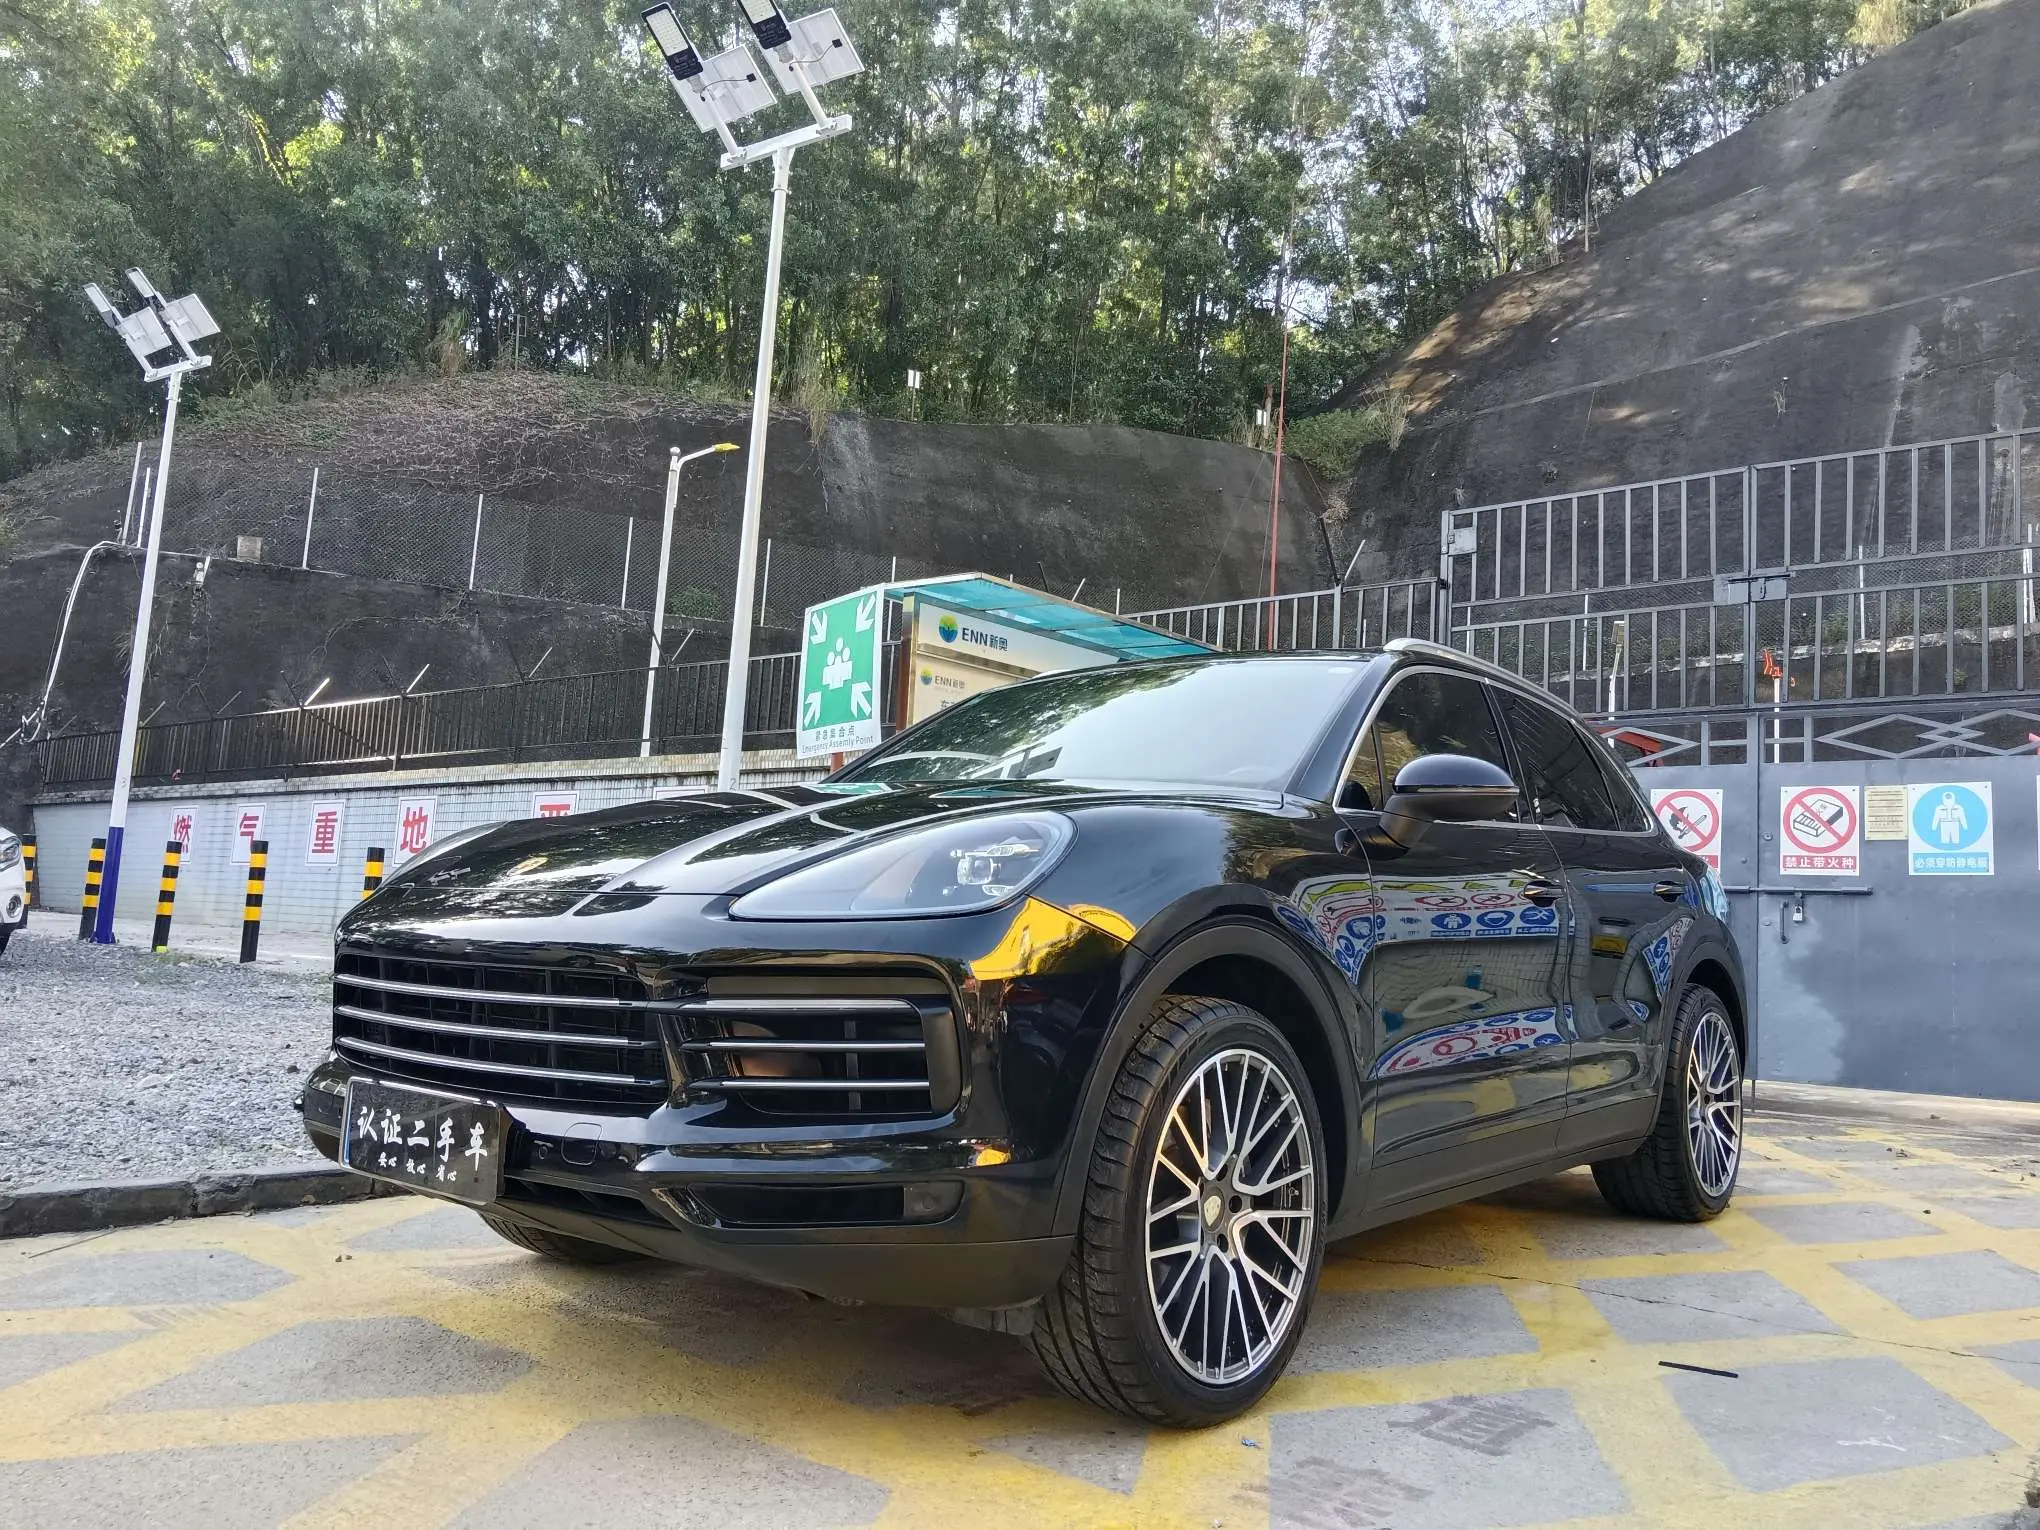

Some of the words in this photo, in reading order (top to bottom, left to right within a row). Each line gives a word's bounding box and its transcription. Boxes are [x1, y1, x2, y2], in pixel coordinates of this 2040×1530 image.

[856, 735, 874, 745] Point
[1784, 856, 1856, 869] 禁止带火种
[357, 1106, 488, 1172] 认证二手车
